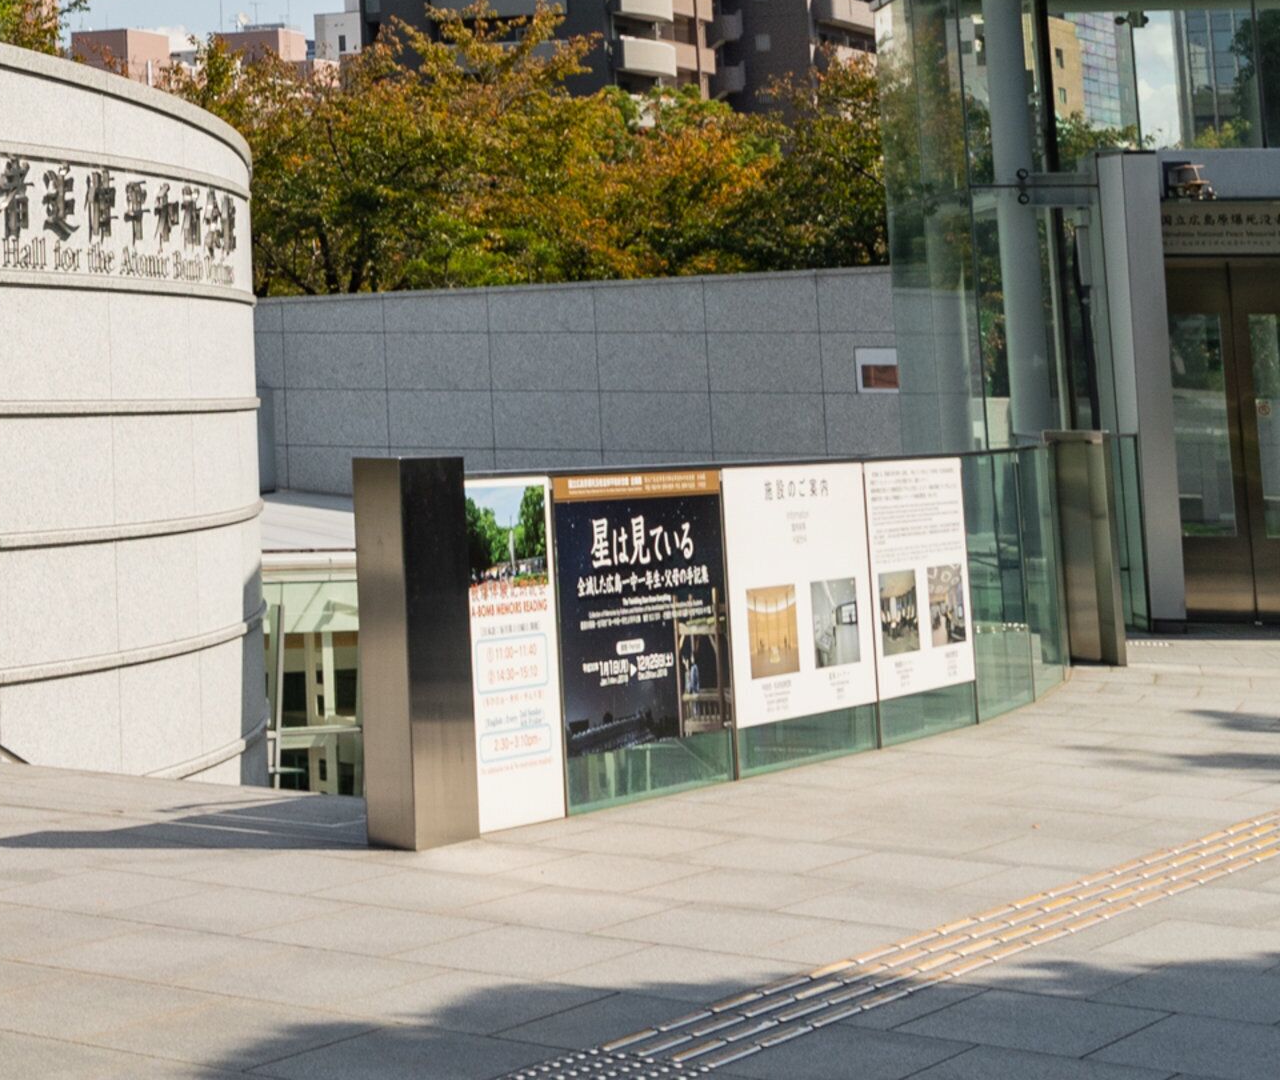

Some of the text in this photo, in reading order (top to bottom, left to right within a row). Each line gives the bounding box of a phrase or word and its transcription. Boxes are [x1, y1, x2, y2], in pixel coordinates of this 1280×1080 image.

[2, 236, 47, 270] Hall
[54, 238, 80, 272] for
[87, 242, 115, 274] the
[120, 246, 169, 279] Atomic
[173, 251, 202, 281] Bomb
[591, 515, 694, 568] 星は見ている
